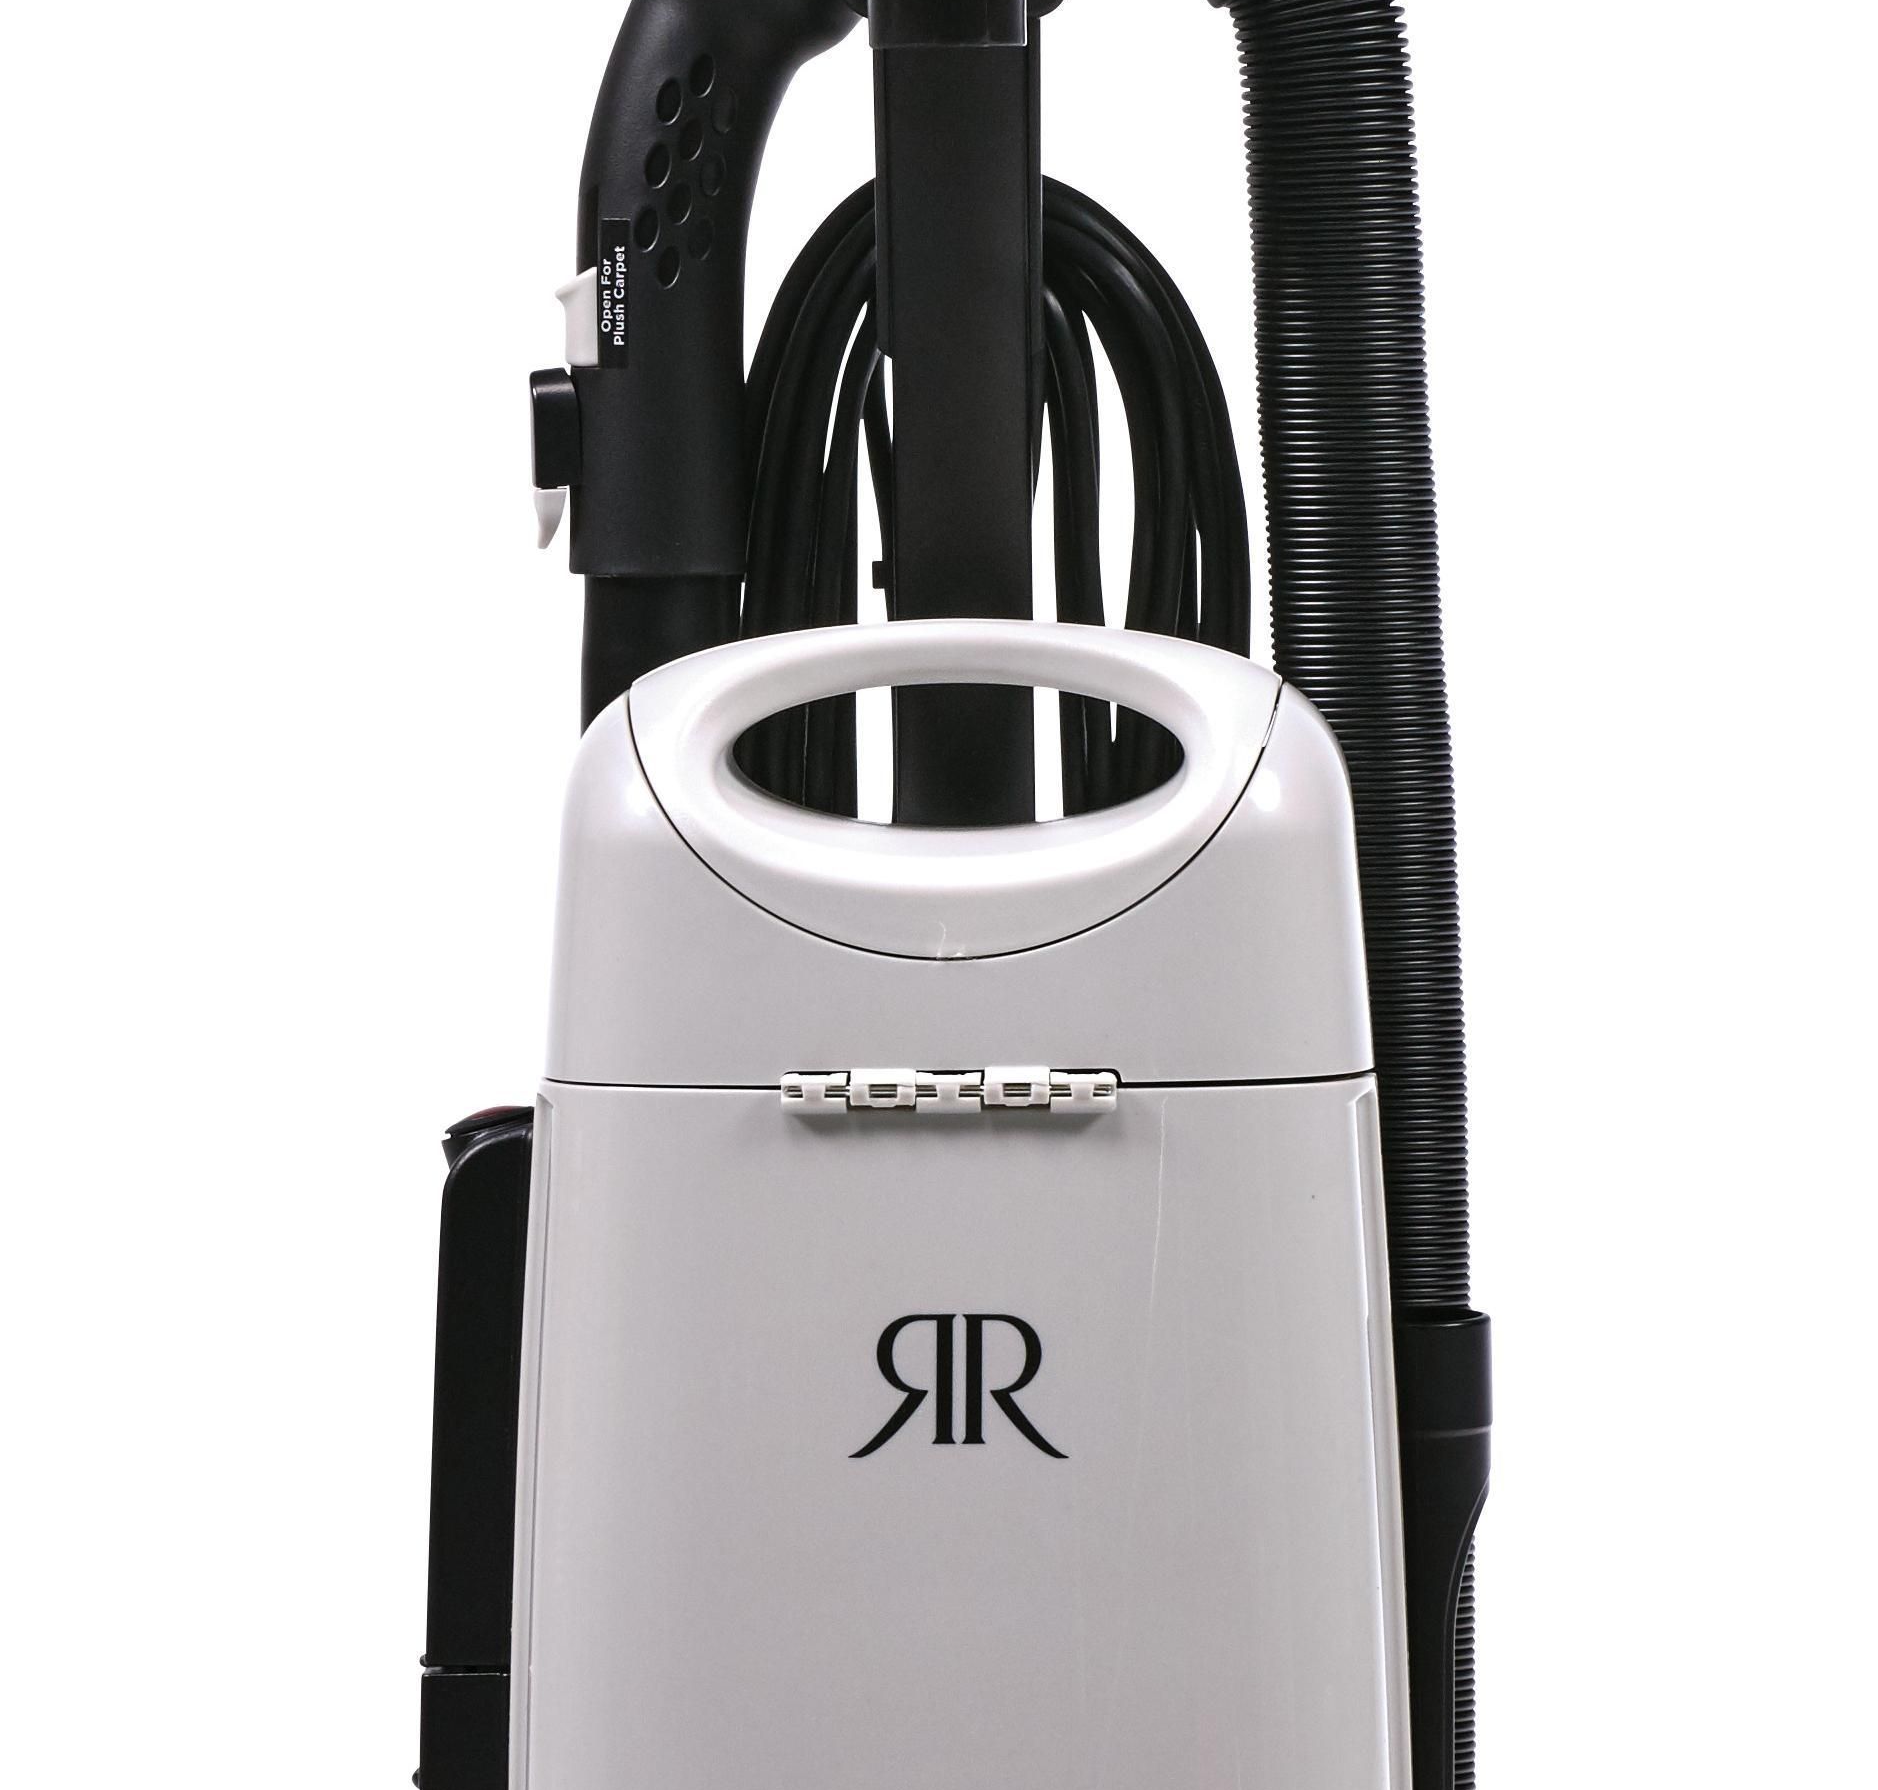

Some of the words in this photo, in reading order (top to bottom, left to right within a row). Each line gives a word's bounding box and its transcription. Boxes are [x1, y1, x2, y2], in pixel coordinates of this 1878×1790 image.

[601, 258, 612, 285] For
[613, 245, 627, 299] Carpet
[601, 291, 613, 332] Open
[613, 304, 625, 346] Plush
